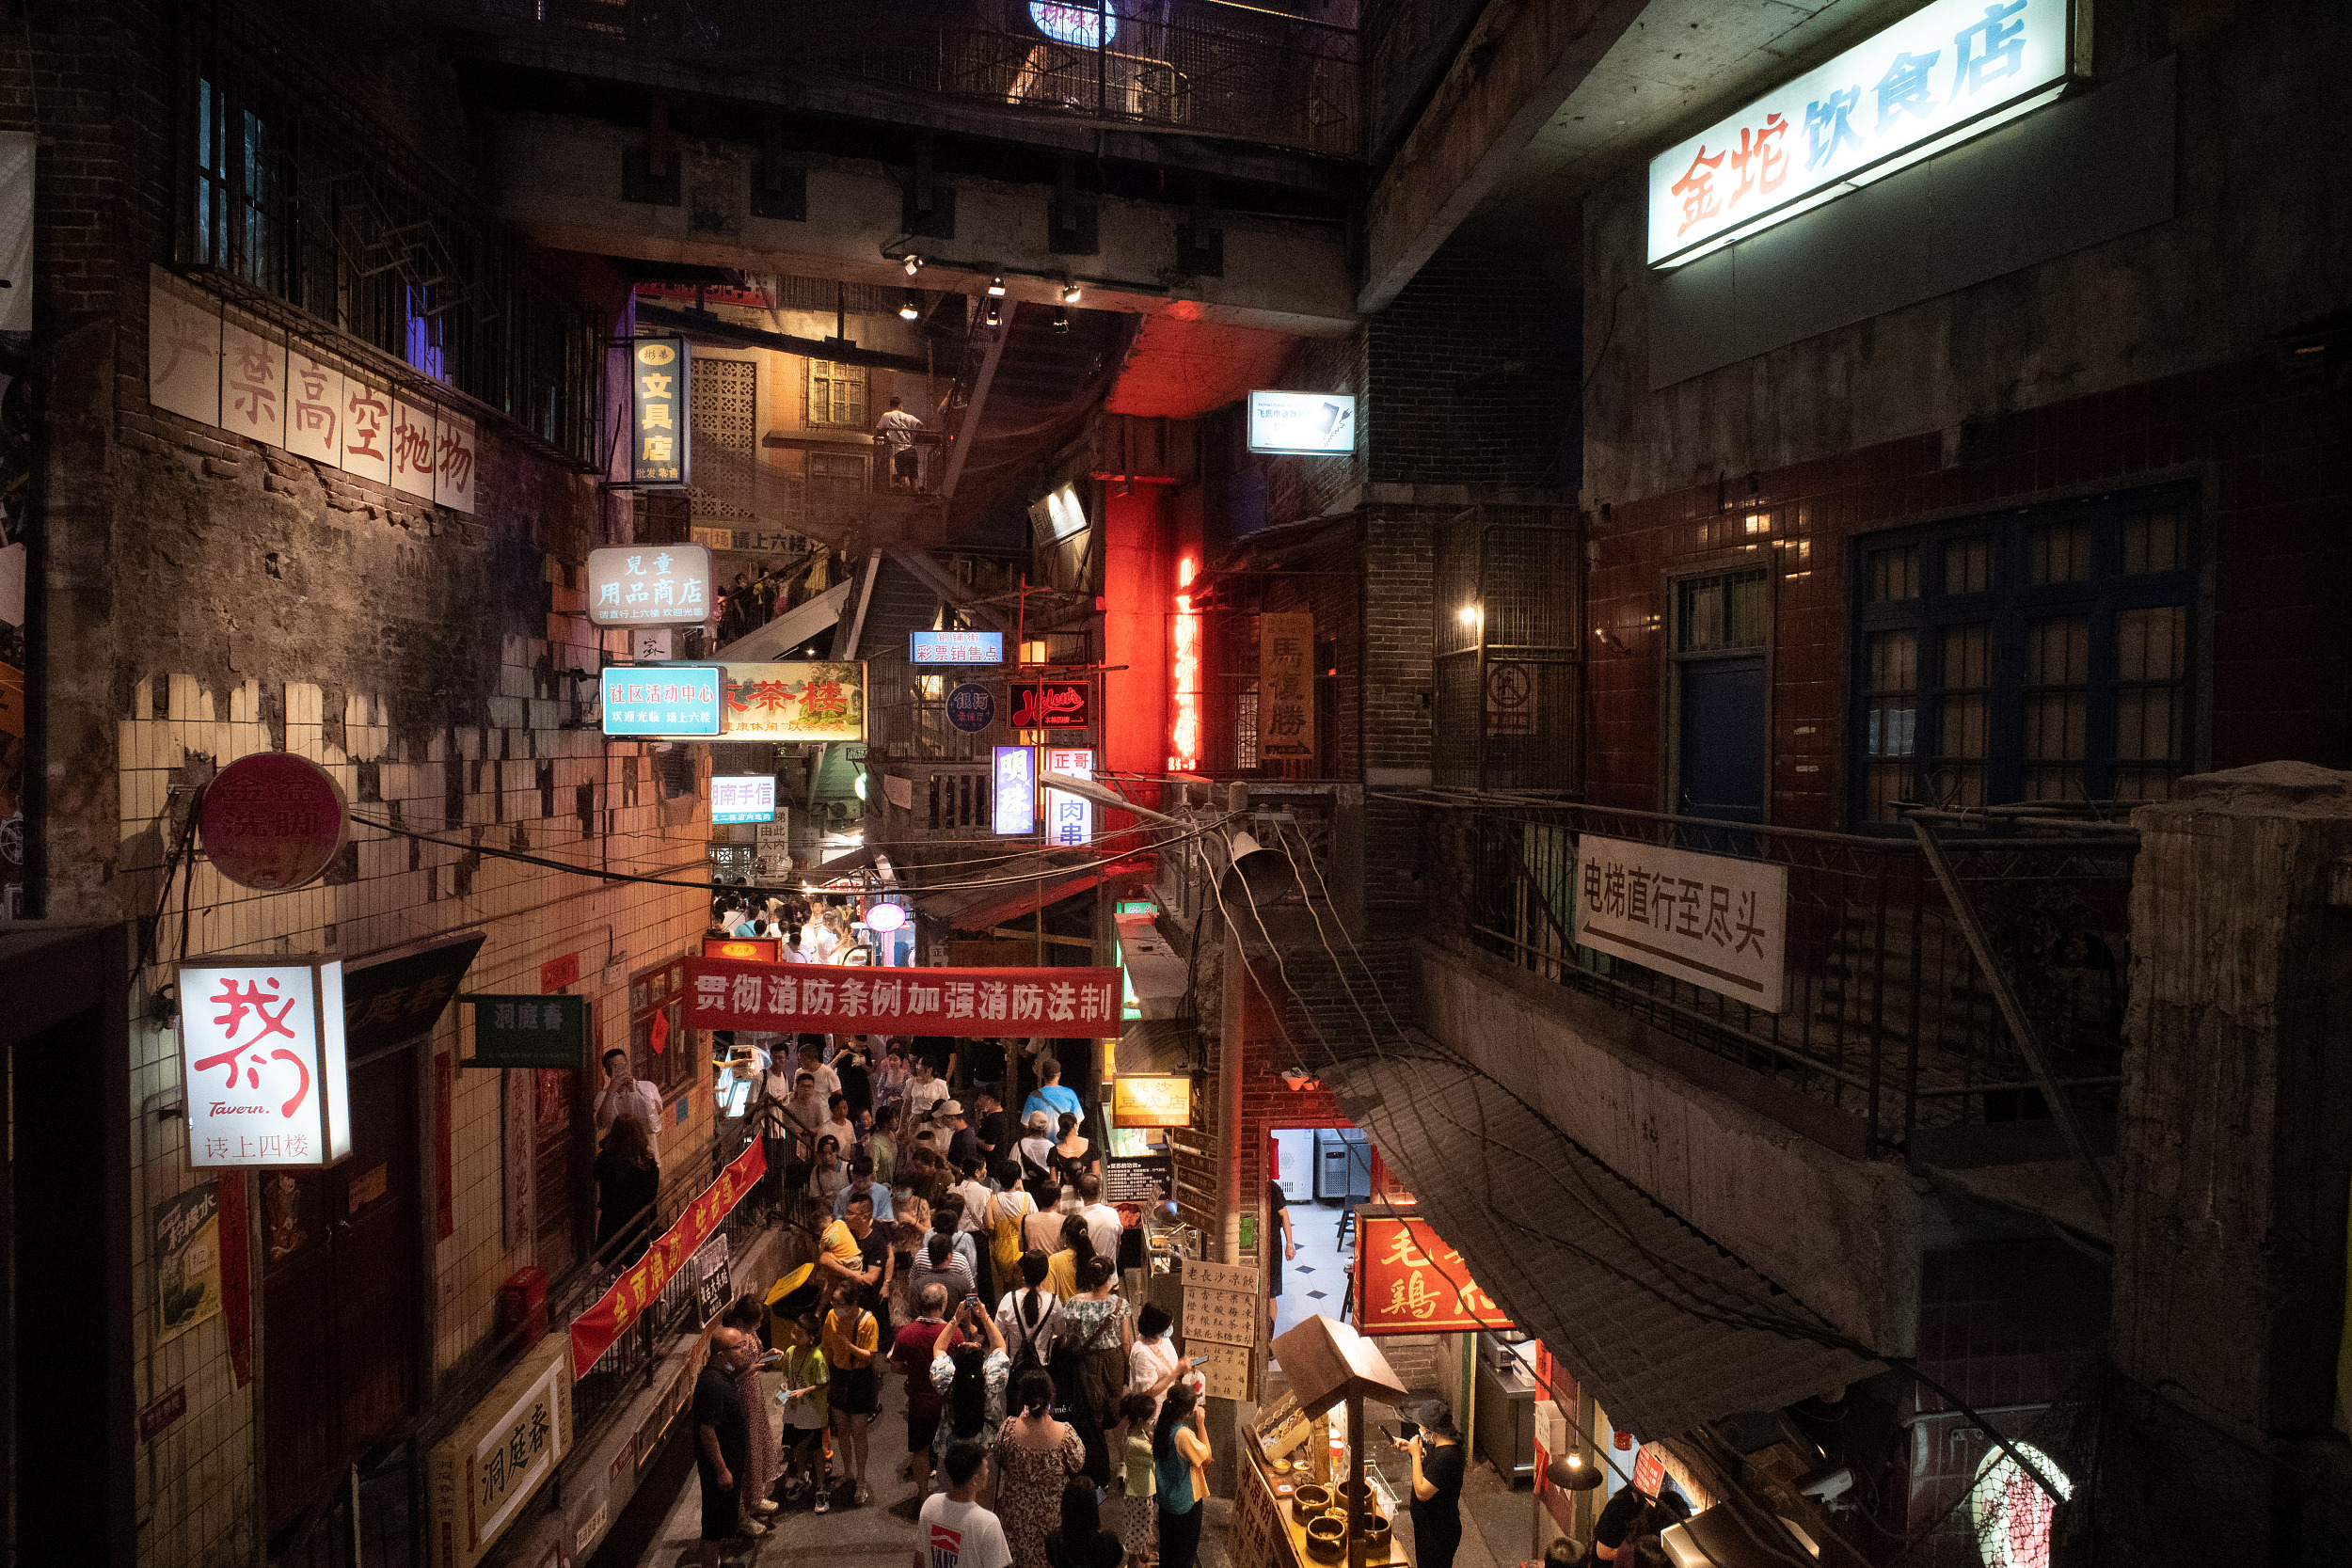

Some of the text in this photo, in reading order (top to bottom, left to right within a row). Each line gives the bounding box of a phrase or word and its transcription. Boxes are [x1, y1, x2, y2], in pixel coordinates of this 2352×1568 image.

[1671, 0, 2028, 238] 金蛇饮食店
[154, 316, 470, 494] 严禁高空抛物
[642, 372, 673, 461] 文具店
[636, 468, 656, 479] 批发
[625, 552, 675, 576] 兒童
[597, 578, 702, 606] 用品商店
[599, 607, 704, 619] 请直行上六楼 欢迎光临
[916, 644, 999, 661] 彩票销售点
[609, 684, 714, 704] 社区活动中心
[954, 691, 988, 709] 银河
[612, 710, 711, 723] 欢迎光临 请上六楼
[1055, 753, 1089, 769] 正哥
[1000, 749, 1030, 816] 明珠
[1059, 773, 1084, 846] 肉串
[1584, 857, 1765, 960] 电梯直行至尽头
[694, 973, 1112, 1022] 贯彻消防条例加强消防法制
[209, 1101, 270, 1117] Tavern.
[1119, 1095, 1187, 1110] 豆皮店
